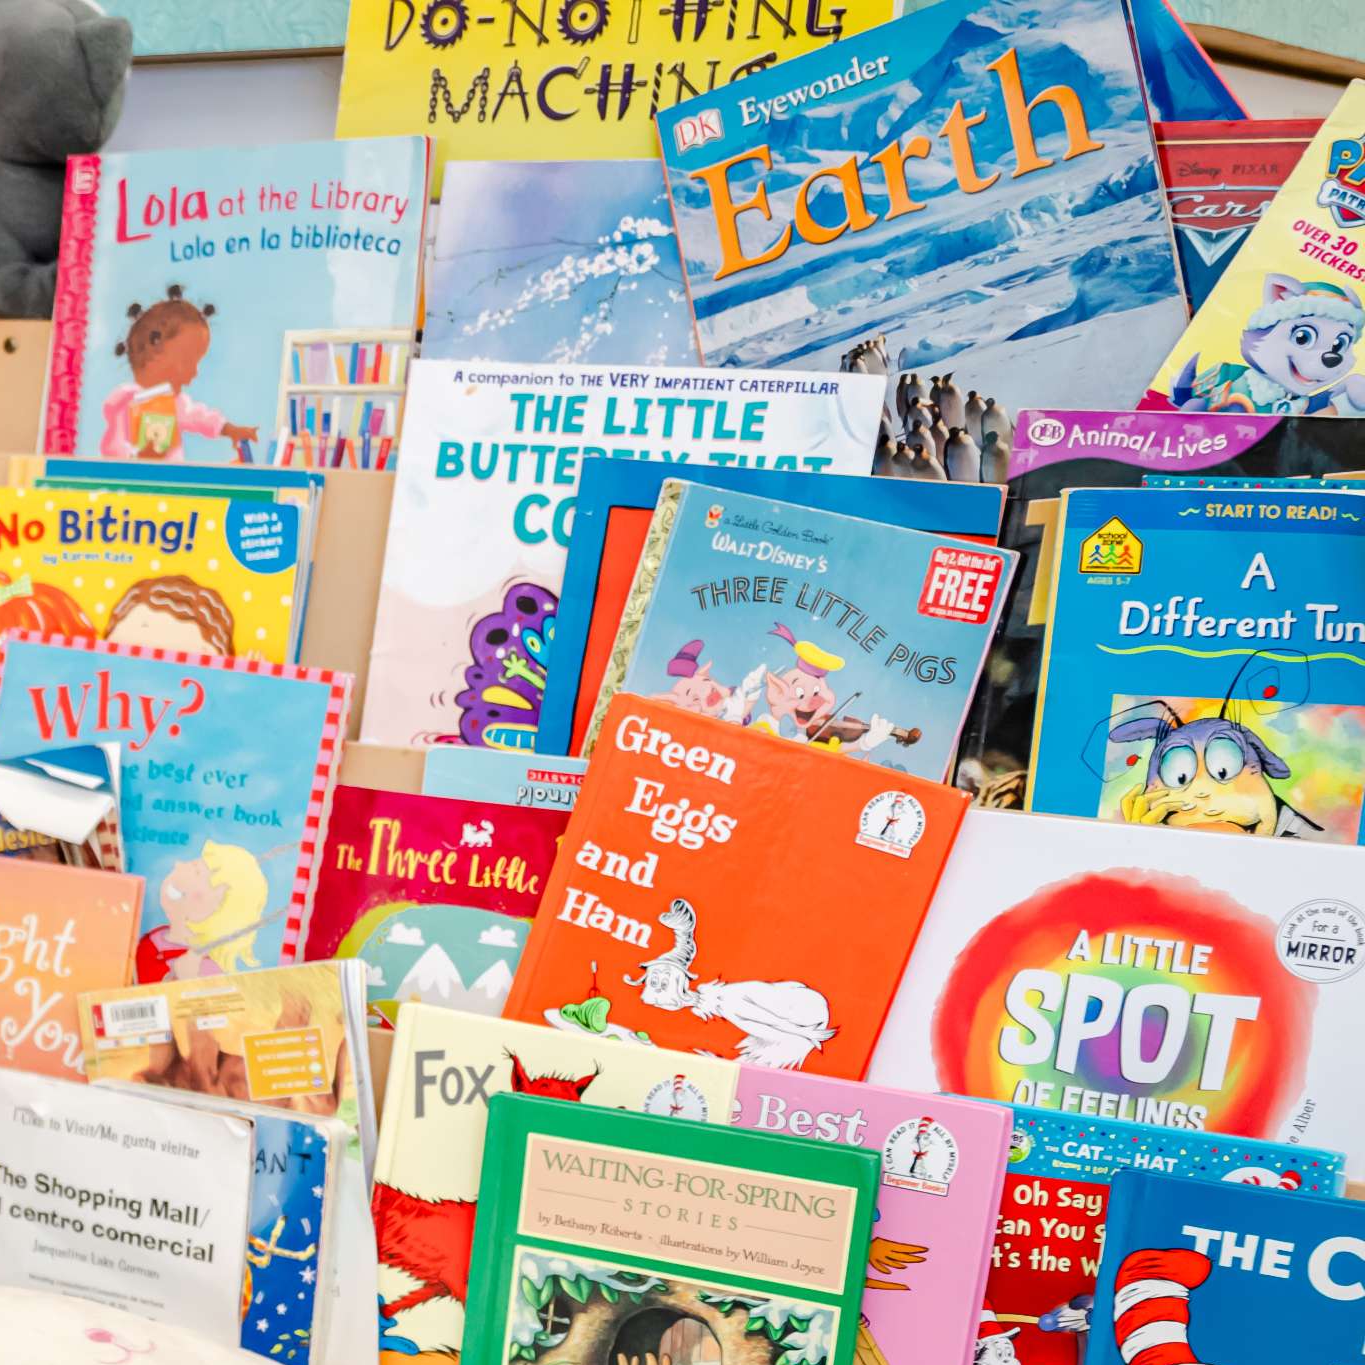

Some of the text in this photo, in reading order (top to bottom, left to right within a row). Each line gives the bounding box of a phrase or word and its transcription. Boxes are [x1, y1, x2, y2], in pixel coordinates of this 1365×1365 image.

[737, 54, 891, 128] Eyewonder
[678, 113, 721, 147] DK
[689, 48, 1105, 283] Earth
[1177, 161, 1279, 180] Disney PIXAR
[115, 178, 209, 244] Lola
[217, 188, 247, 218] at
[258, 183, 298, 213] the
[311, 181, 409, 226] Library
[1171, 194, 1272, 219] Cars
[170, 224, 401, 263] Lola en la biblioteca
[1292, 219, 1359, 256] OVER 30
[453, 370, 840, 396] A companion to THE VERY IMPATIENT CATERPILLAR
[510, 392, 770, 442] THE LITTLE
[1068, 424, 1228, 459] Animal Lives
[58, 505, 199, 555] Biting!
[733, 514, 831, 546] Little Golden Book
[1205, 503, 1338, 523] START TO READ!
[711, 530, 829, 575] WALT DISNEY'S
[1240, 551, 1277, 591] A
[926, 566, 994, 613] FREE
[689, 575, 958, 686] THREE LITTLE PIGS
[1118, 595, 1298, 641] Different
[28, 669, 206, 752] Why?
[148, 759, 194, 784] best
[202, 768, 250, 789] ever
[614, 713, 737, 785] Green
[151, 796, 226, 822] answer
[232, 798, 283, 829] book
[624, 776, 738, 851] Eggs
[335, 816, 541, 896] The Three Little
[575, 838, 657, 890] and
[556, 886, 654, 949] Ham
[1066, 929, 1214, 975] A LITTLE
[1285, 940, 1357, 965] MIRROR
[0, 976, 88, 1079] You
[997, 967, 1263, 1092] SPOT
[413, 1048, 497, 1119] Fox
[1012, 1078, 1208, 1131] OF FEELINGS
[19, 1109, 201, 1160] Like to Visit/Me gusta visitar
[754, 1093, 868, 1147] Best
[1062, 1141, 1179, 1173] CAT HAT
[33, 1171, 143, 1220] Shopping
[148, 1196, 212, 1231] Mall/
[541, 1148, 839, 1220] WAITING-FOR-SPRING
[1013, 1180, 1103, 1217] Oh Say
[8, 1201, 85, 1235] centro
[91, 1220, 215, 1265] comercial
[622, 1197, 740, 1231] STORIES
[1039, 1217, 1086, 1241] You
[537, 1210, 826, 1277] by Bethany Roberts illustrations by William Joyce
[1028, 1245, 1072, 1273] the
[1180, 1223, 1297, 1280] THE
